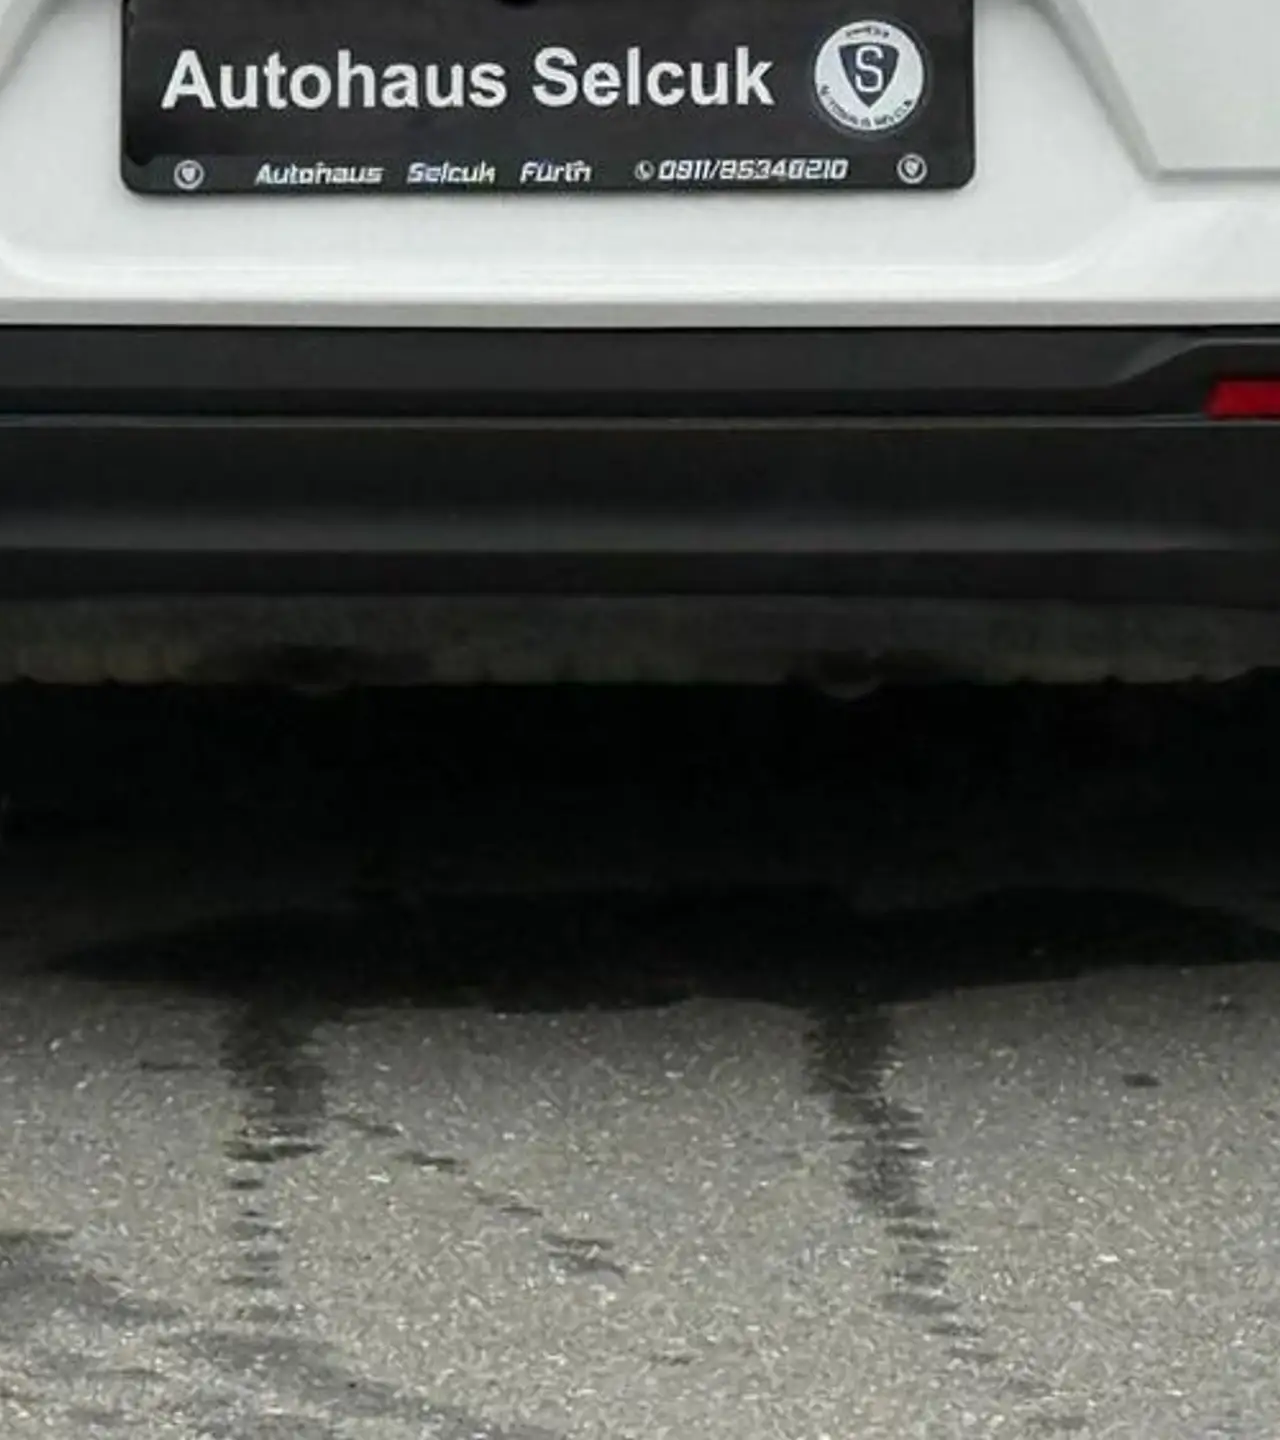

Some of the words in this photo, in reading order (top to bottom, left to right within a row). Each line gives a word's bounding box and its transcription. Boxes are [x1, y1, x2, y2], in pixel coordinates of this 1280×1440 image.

[161, 49, 507, 109] Autohaus
[532, 46, 776, 108] Selcuk
[854, 44, 885, 93] S
[254, 161, 384, 185] Autohaus
[406, 160, 497, 184] Selcuk
[519, 159, 592, 183] Fürth
